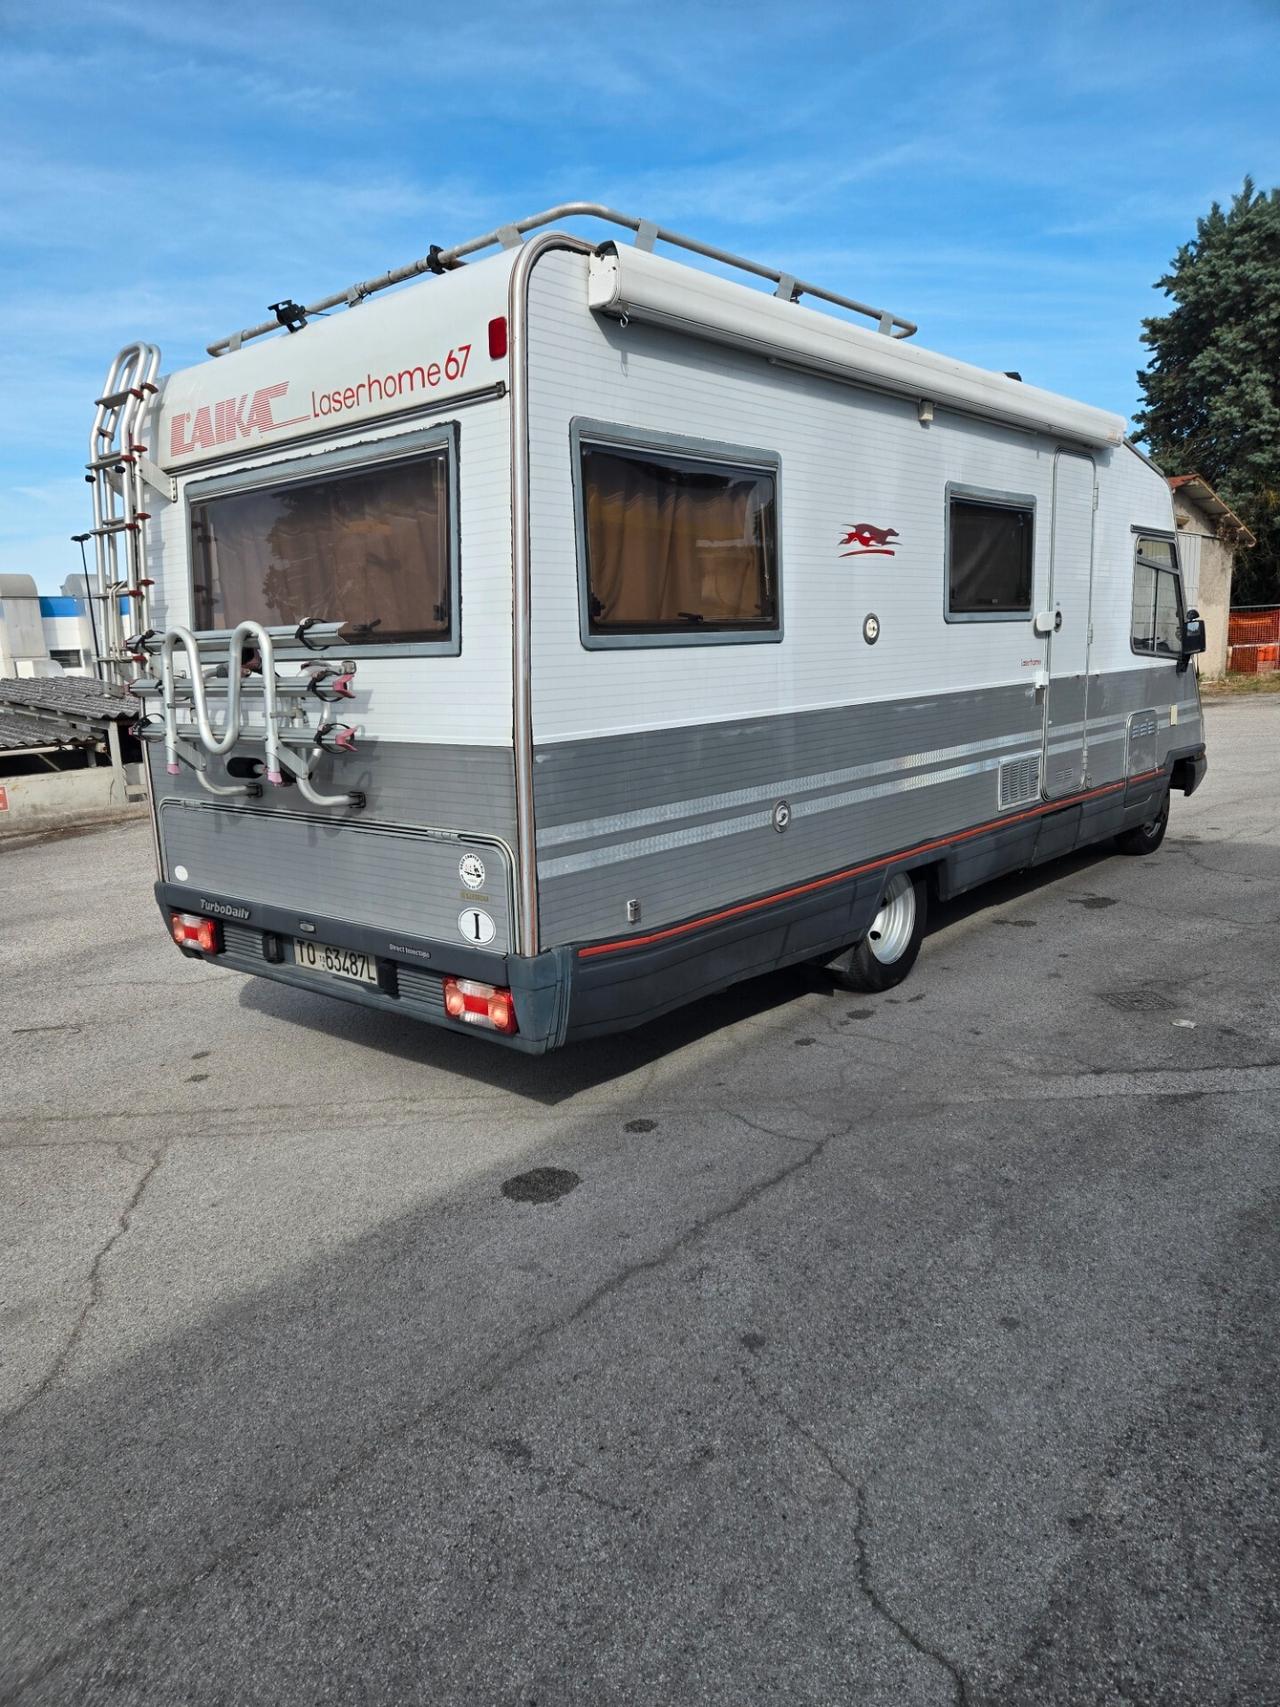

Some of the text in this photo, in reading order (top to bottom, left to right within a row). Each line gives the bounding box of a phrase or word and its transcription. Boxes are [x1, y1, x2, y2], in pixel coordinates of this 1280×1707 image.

[170, 380, 294, 457] LAIKA
[200, 898, 250, 920] TurboDaily
[473, 912, 481, 940] I
[297, 940, 316, 966] TO
[325, 946, 376, 981] 63487L
